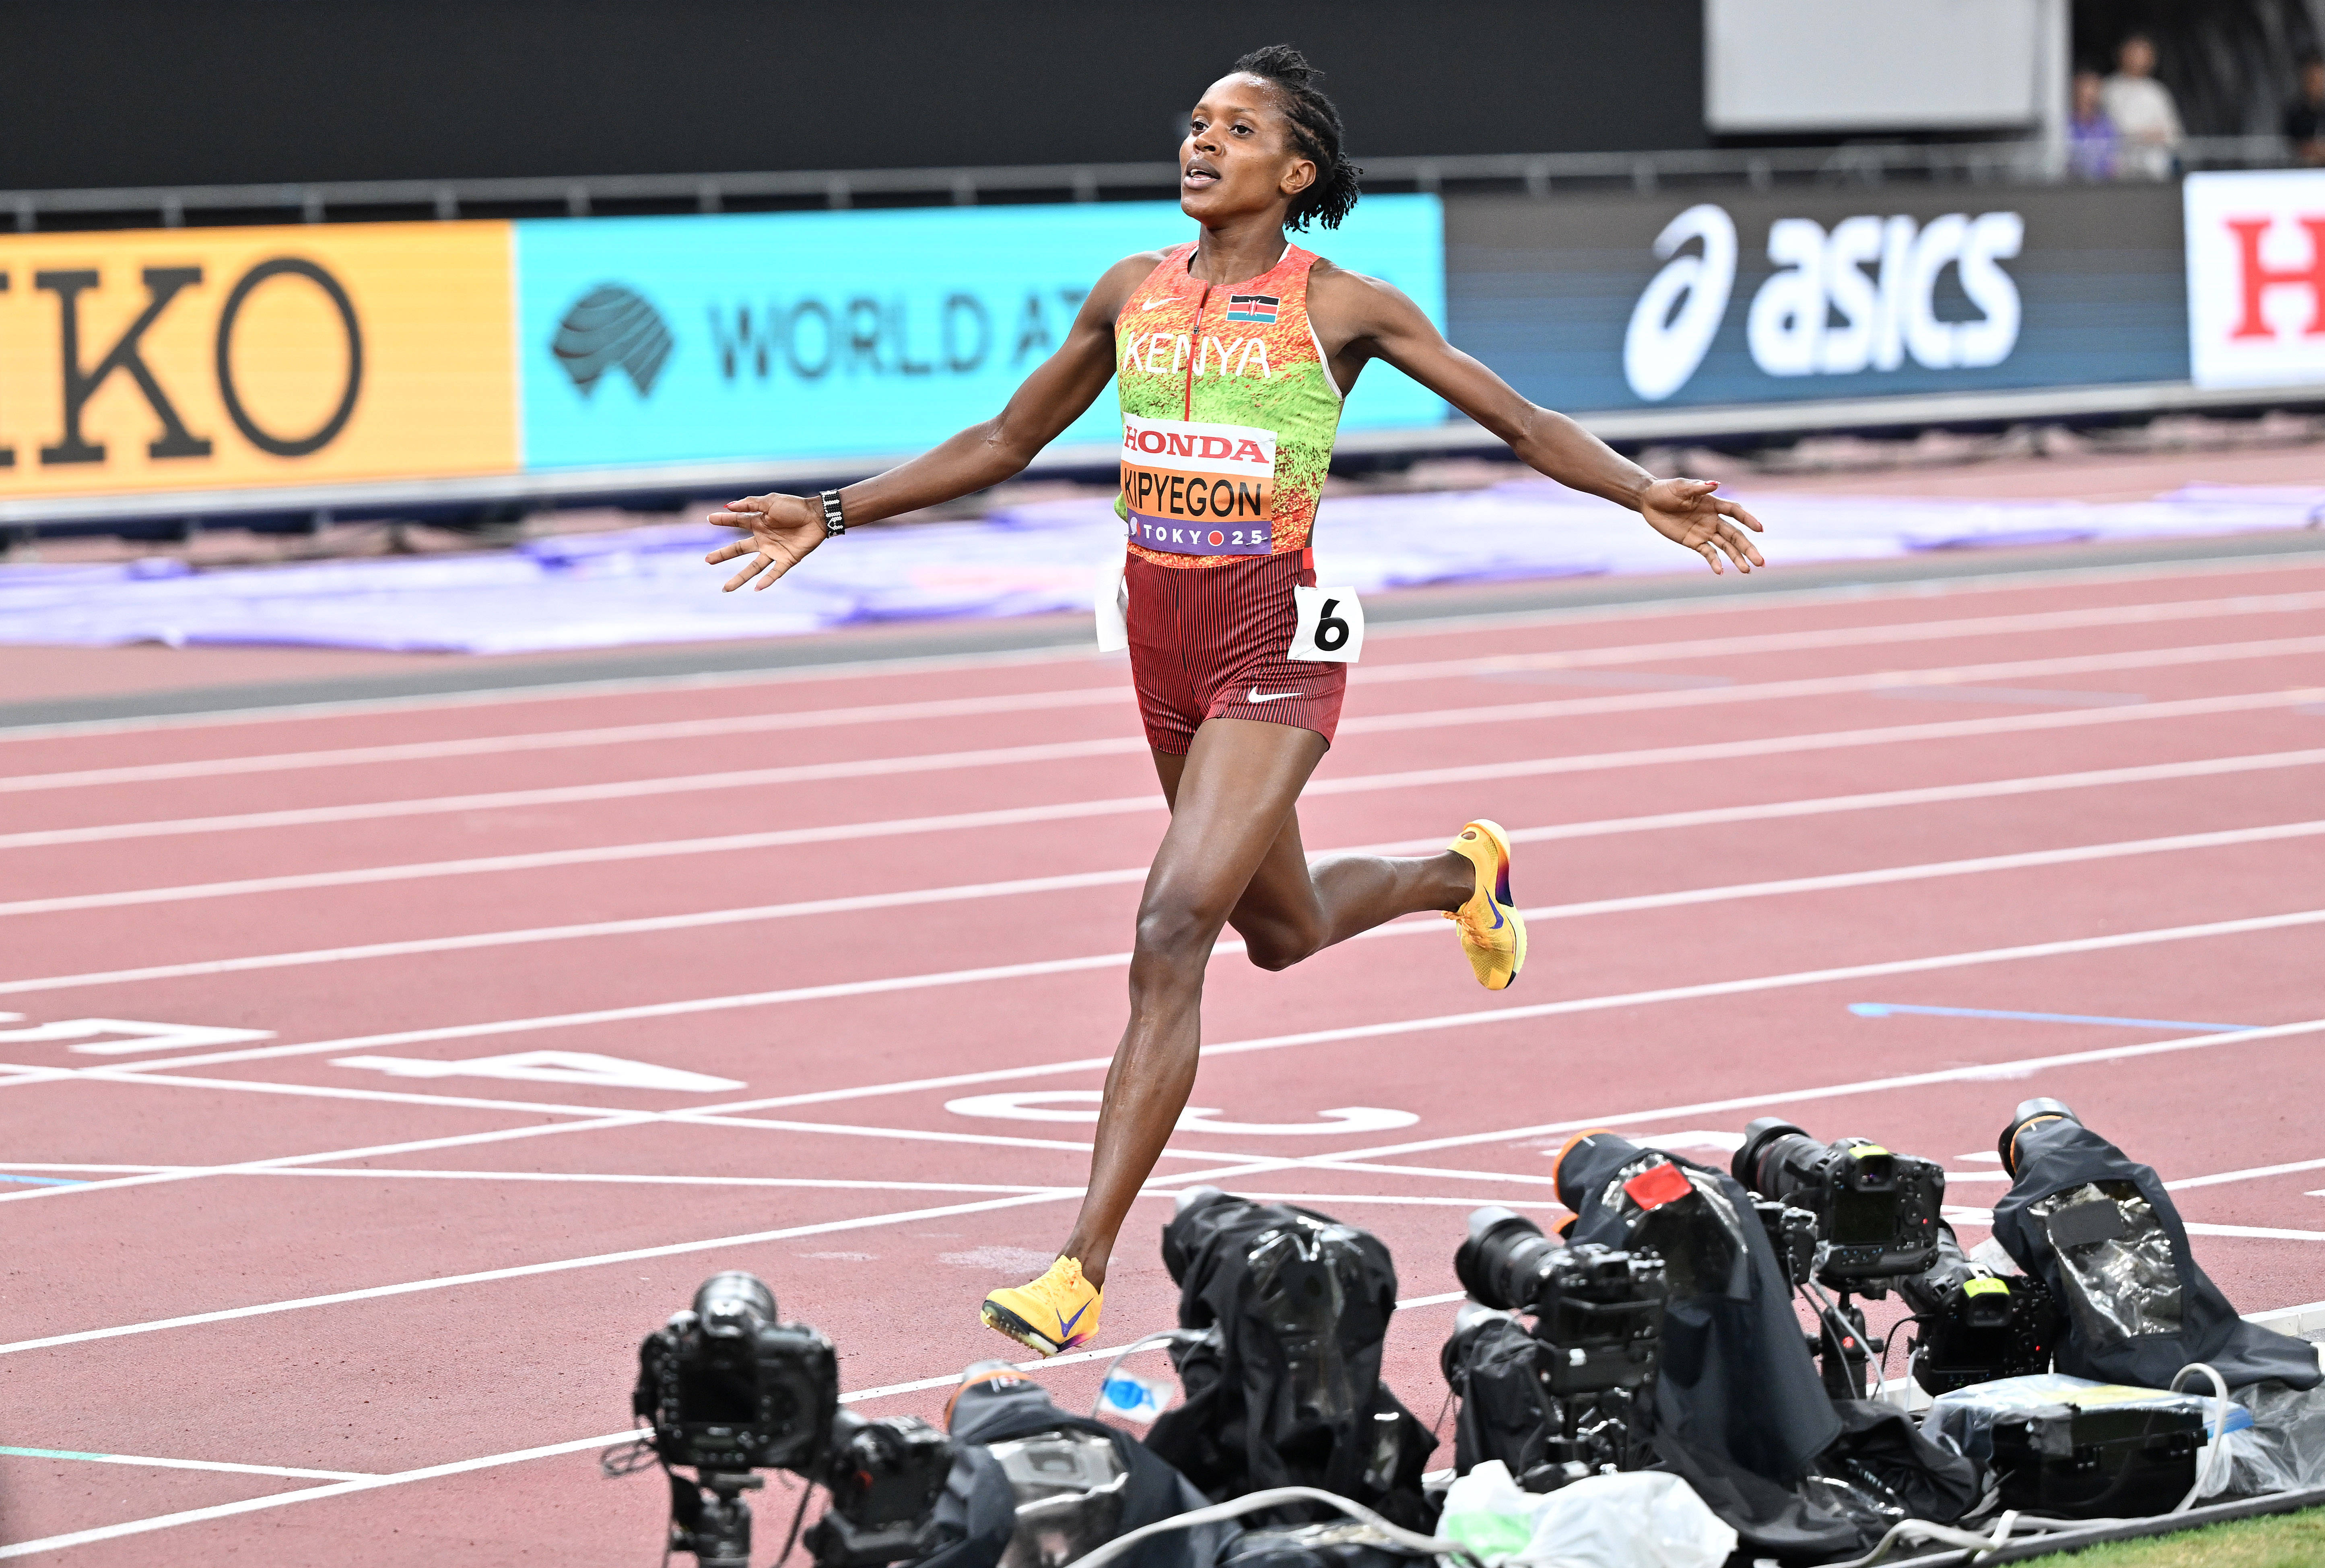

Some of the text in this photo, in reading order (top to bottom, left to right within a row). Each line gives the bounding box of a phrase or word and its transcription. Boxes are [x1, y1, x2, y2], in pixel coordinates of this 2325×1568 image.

[1746, 211, 2025, 375] asics
[706, 291, 990, 380] WORLD
[1123, 331, 1272, 379] KENYA
[1124, 425, 1270, 464] HONDA
[1125, 467, 1262, 517] KIPYEGON
[1231, 530, 1262, 545] 25
[1314, 598, 1349, 651] 6
[326, 1050, 749, 1093] 4
